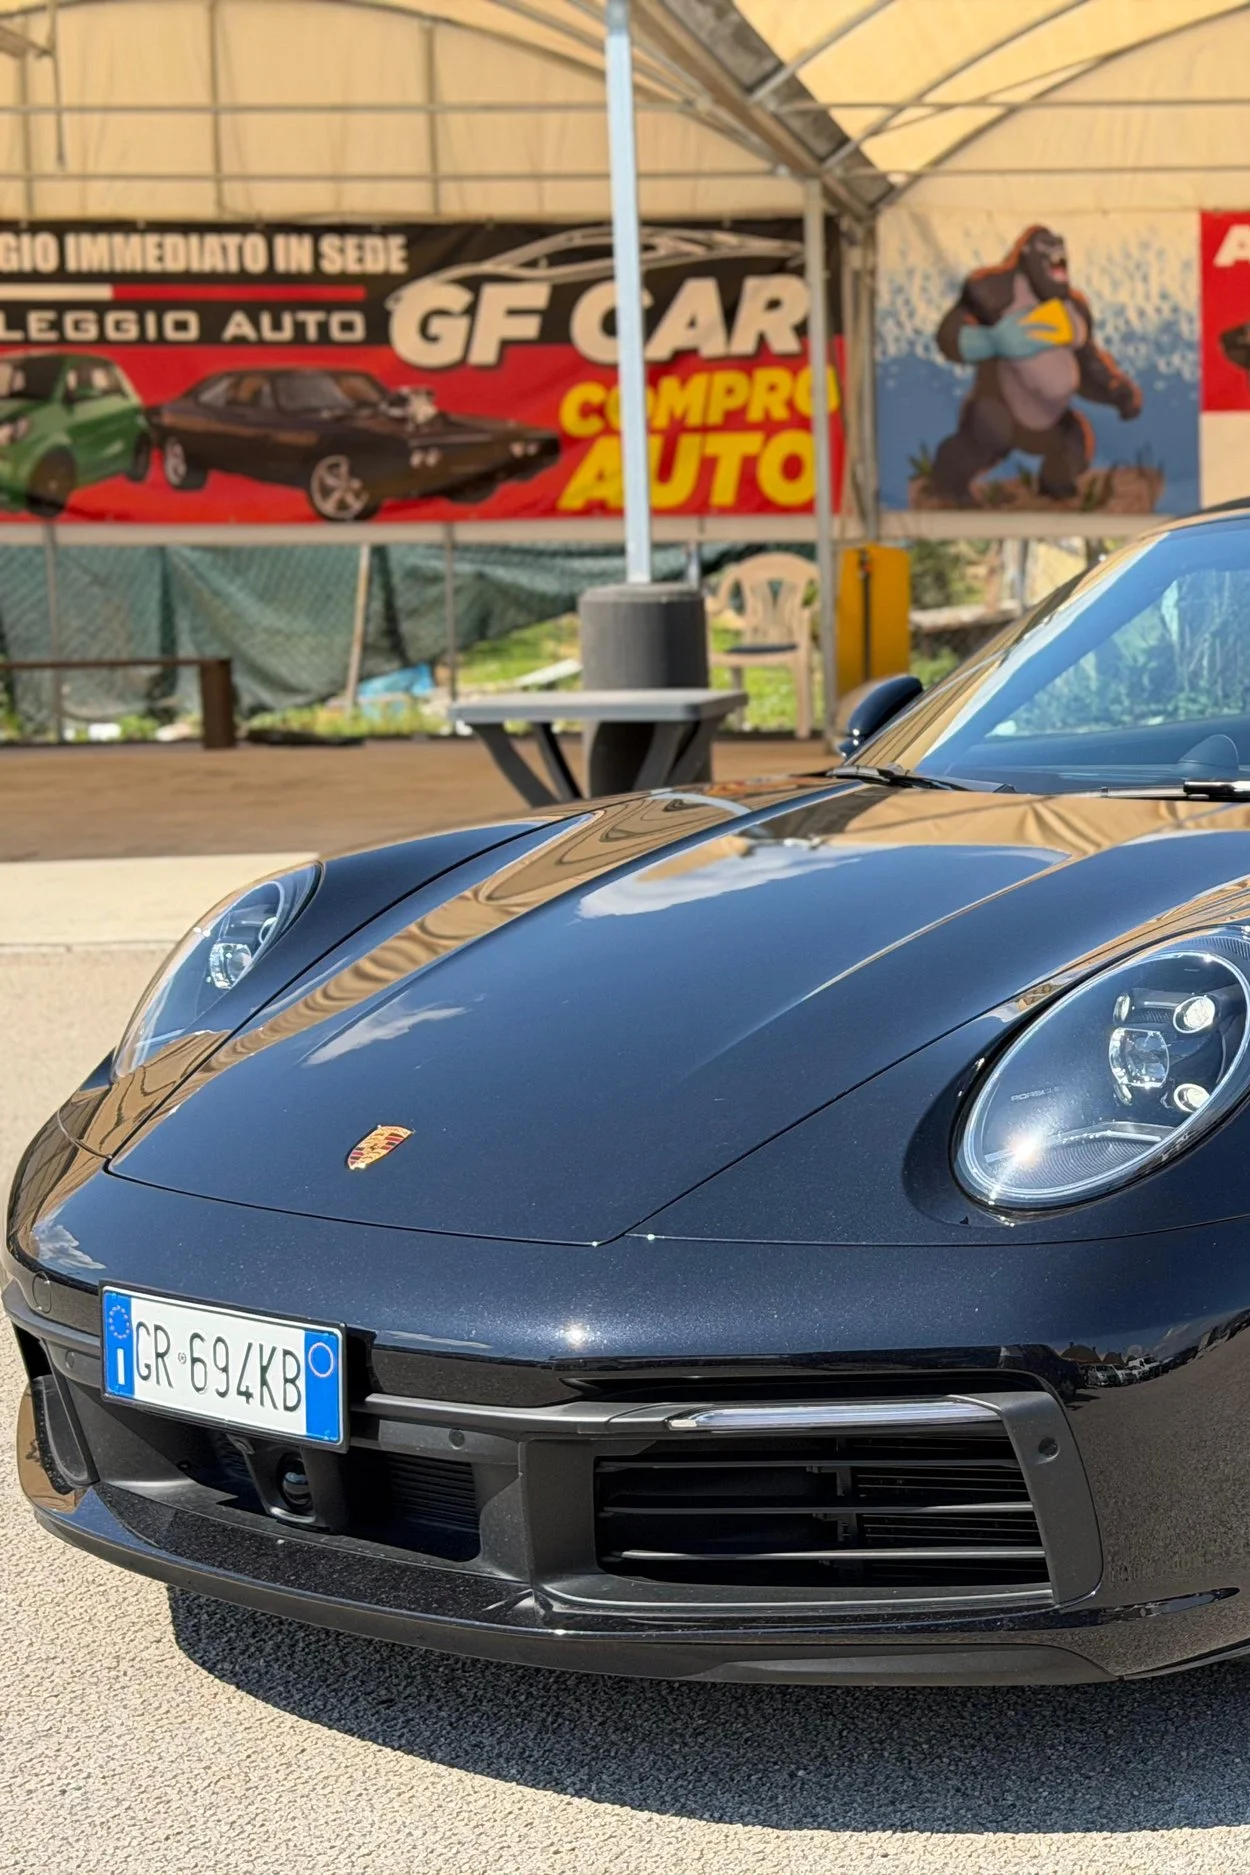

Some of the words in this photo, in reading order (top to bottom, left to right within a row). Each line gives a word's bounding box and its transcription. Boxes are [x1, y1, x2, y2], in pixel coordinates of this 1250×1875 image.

[64, 232, 269, 274] IMMEDIATO
[273, 233, 314, 275] IN
[318, 234, 408, 275] SEDE
[220, 310, 367, 343] AUTO
[388, 281, 552, 369] GF
[569, 273, 811, 365] CAR
[556, 428, 818, 511] AUTO
